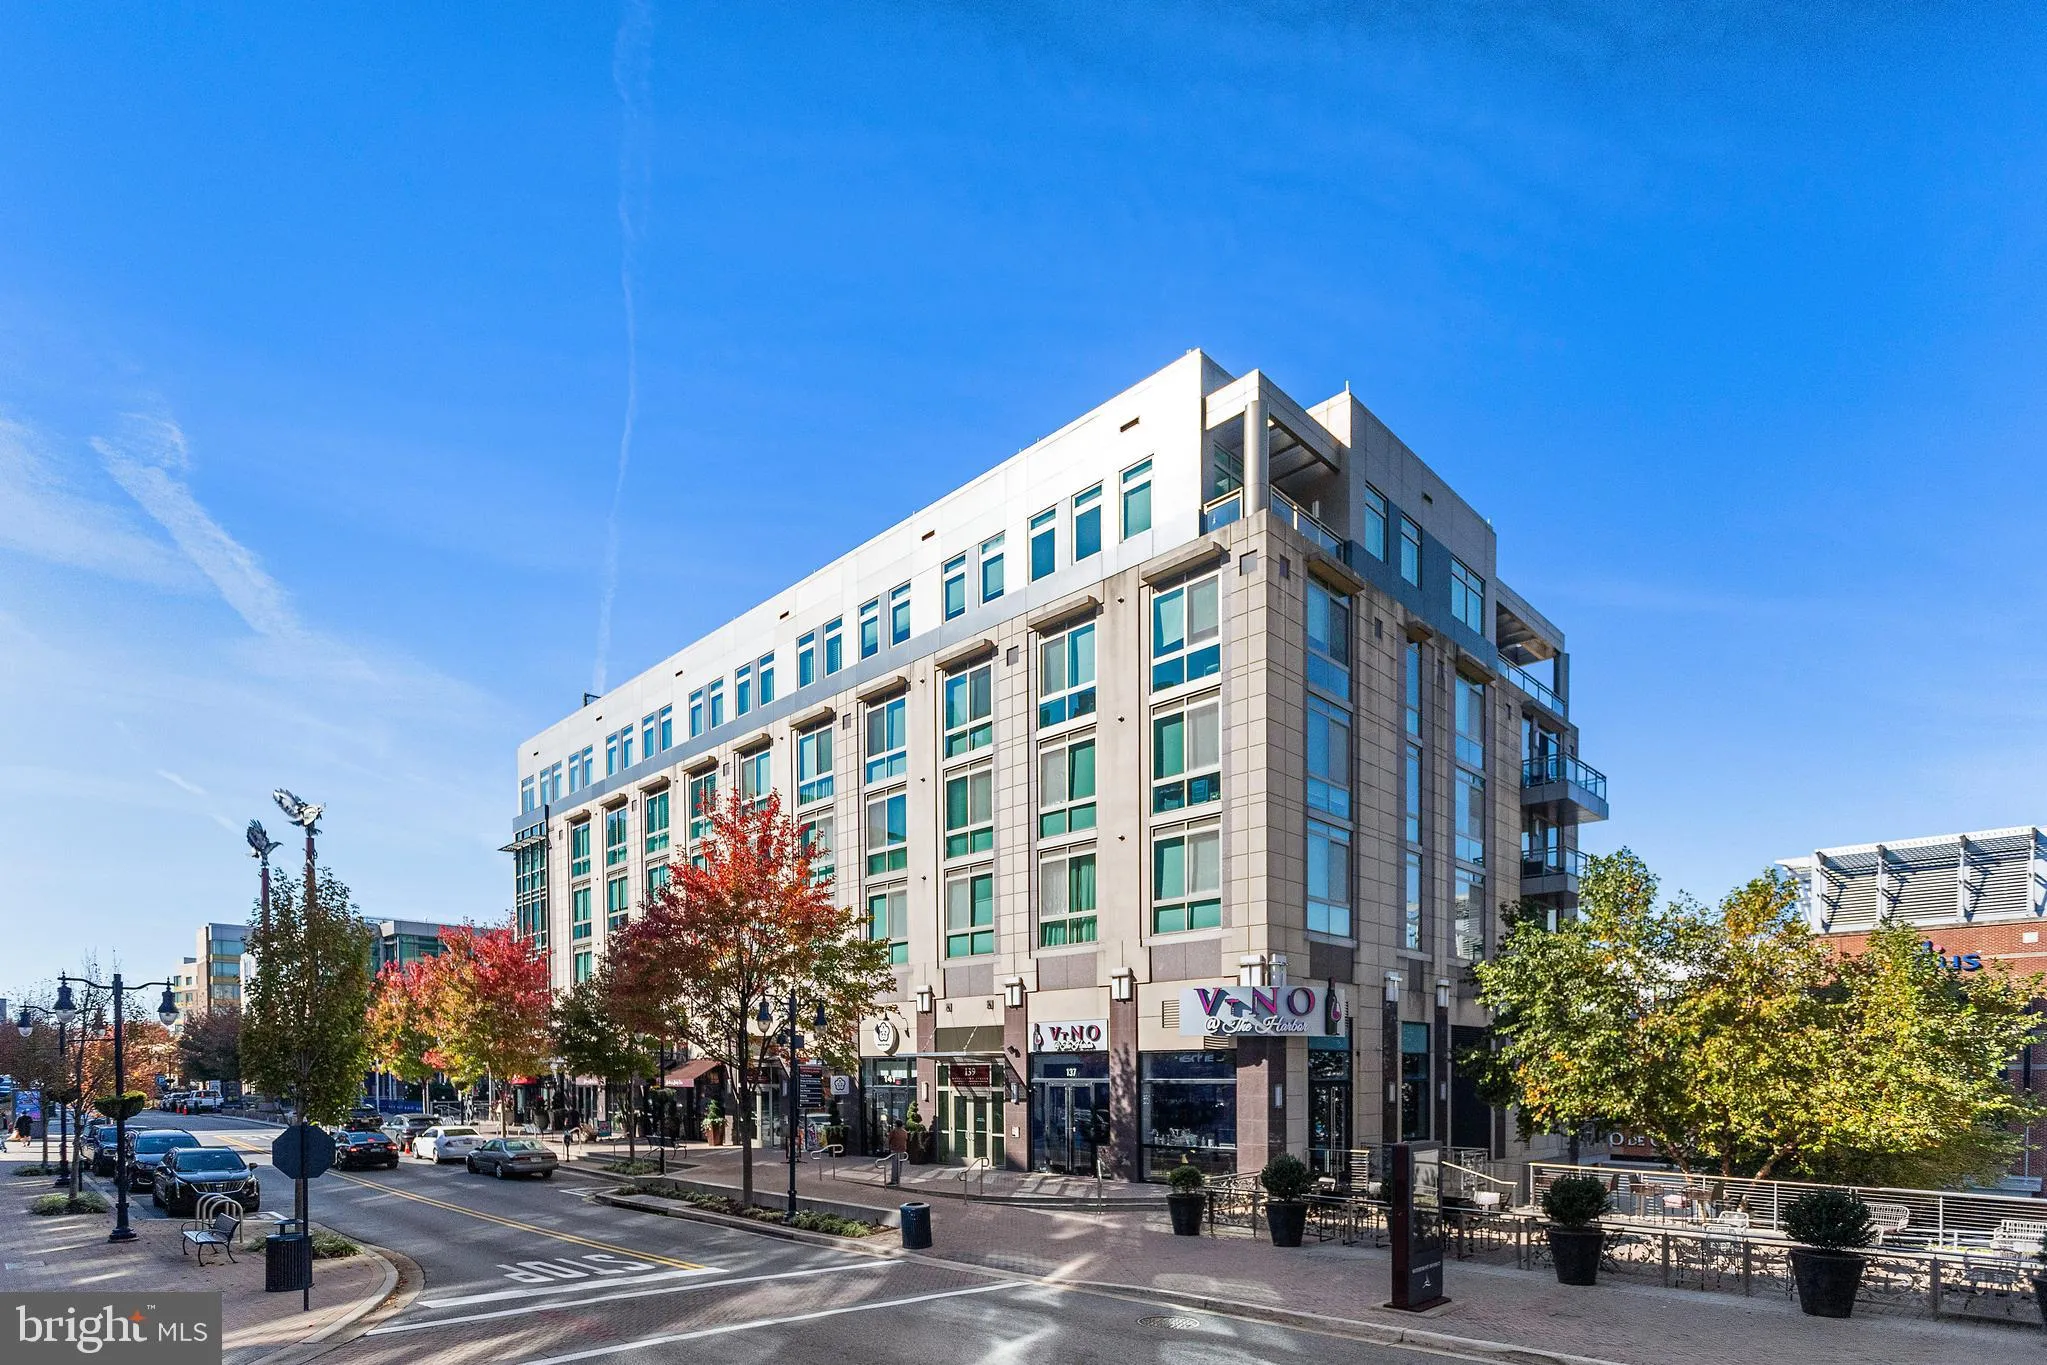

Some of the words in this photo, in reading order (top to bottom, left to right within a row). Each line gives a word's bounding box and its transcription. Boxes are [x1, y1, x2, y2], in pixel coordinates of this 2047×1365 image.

[1205, 1016, 1220, 1032] @
[1222, 1015, 1252, 1034] The
[1254, 1015, 1309, 1035] Harbor
[965, 1067, 976, 1076] 139
[1066, 1068, 1077, 1077] 137
[884, 1075, 896, 1083] 141
[497, 1255, 656, 1283] STOP
